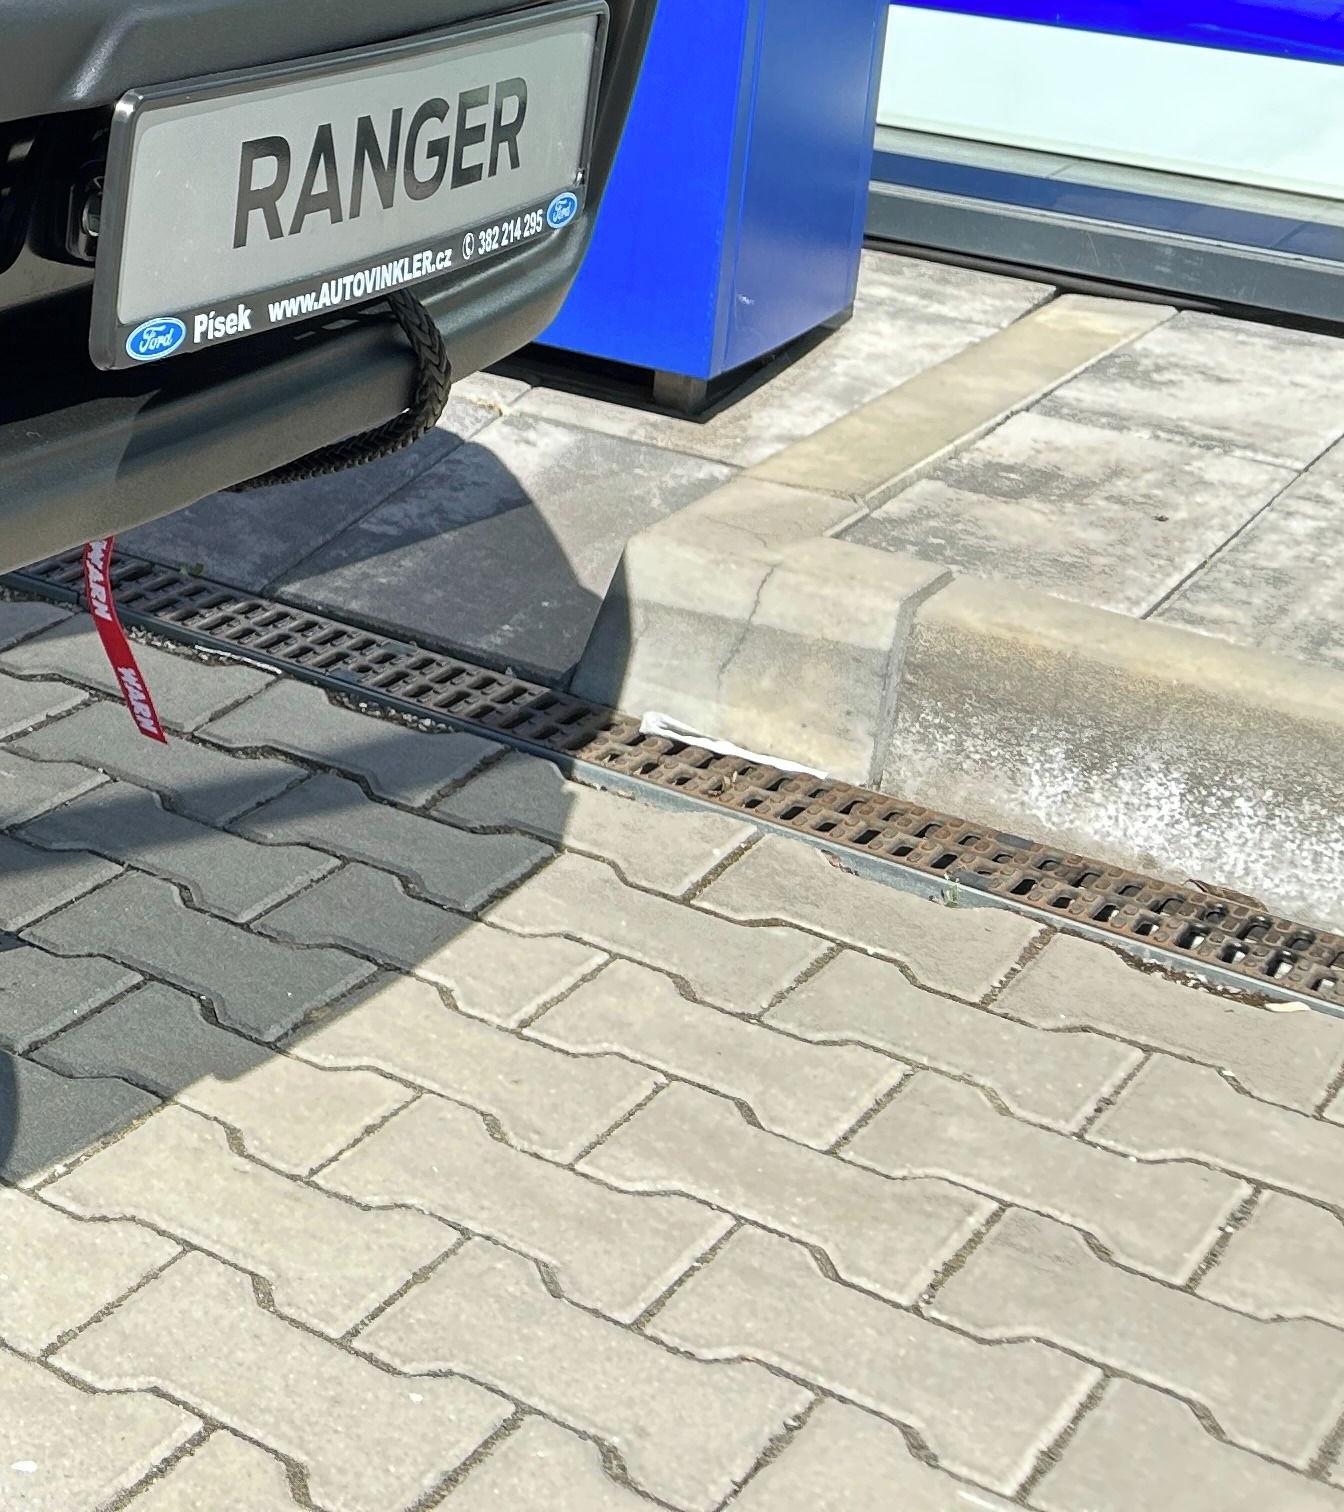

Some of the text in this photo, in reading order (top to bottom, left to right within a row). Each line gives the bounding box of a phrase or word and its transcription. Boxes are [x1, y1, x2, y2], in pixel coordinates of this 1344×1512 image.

[232, 76, 528, 250] RANGER
[138, 324, 174, 354] Ford
[193, 208, 544, 344] Písek www.AUTOVINKLER.cz 382 214 295
